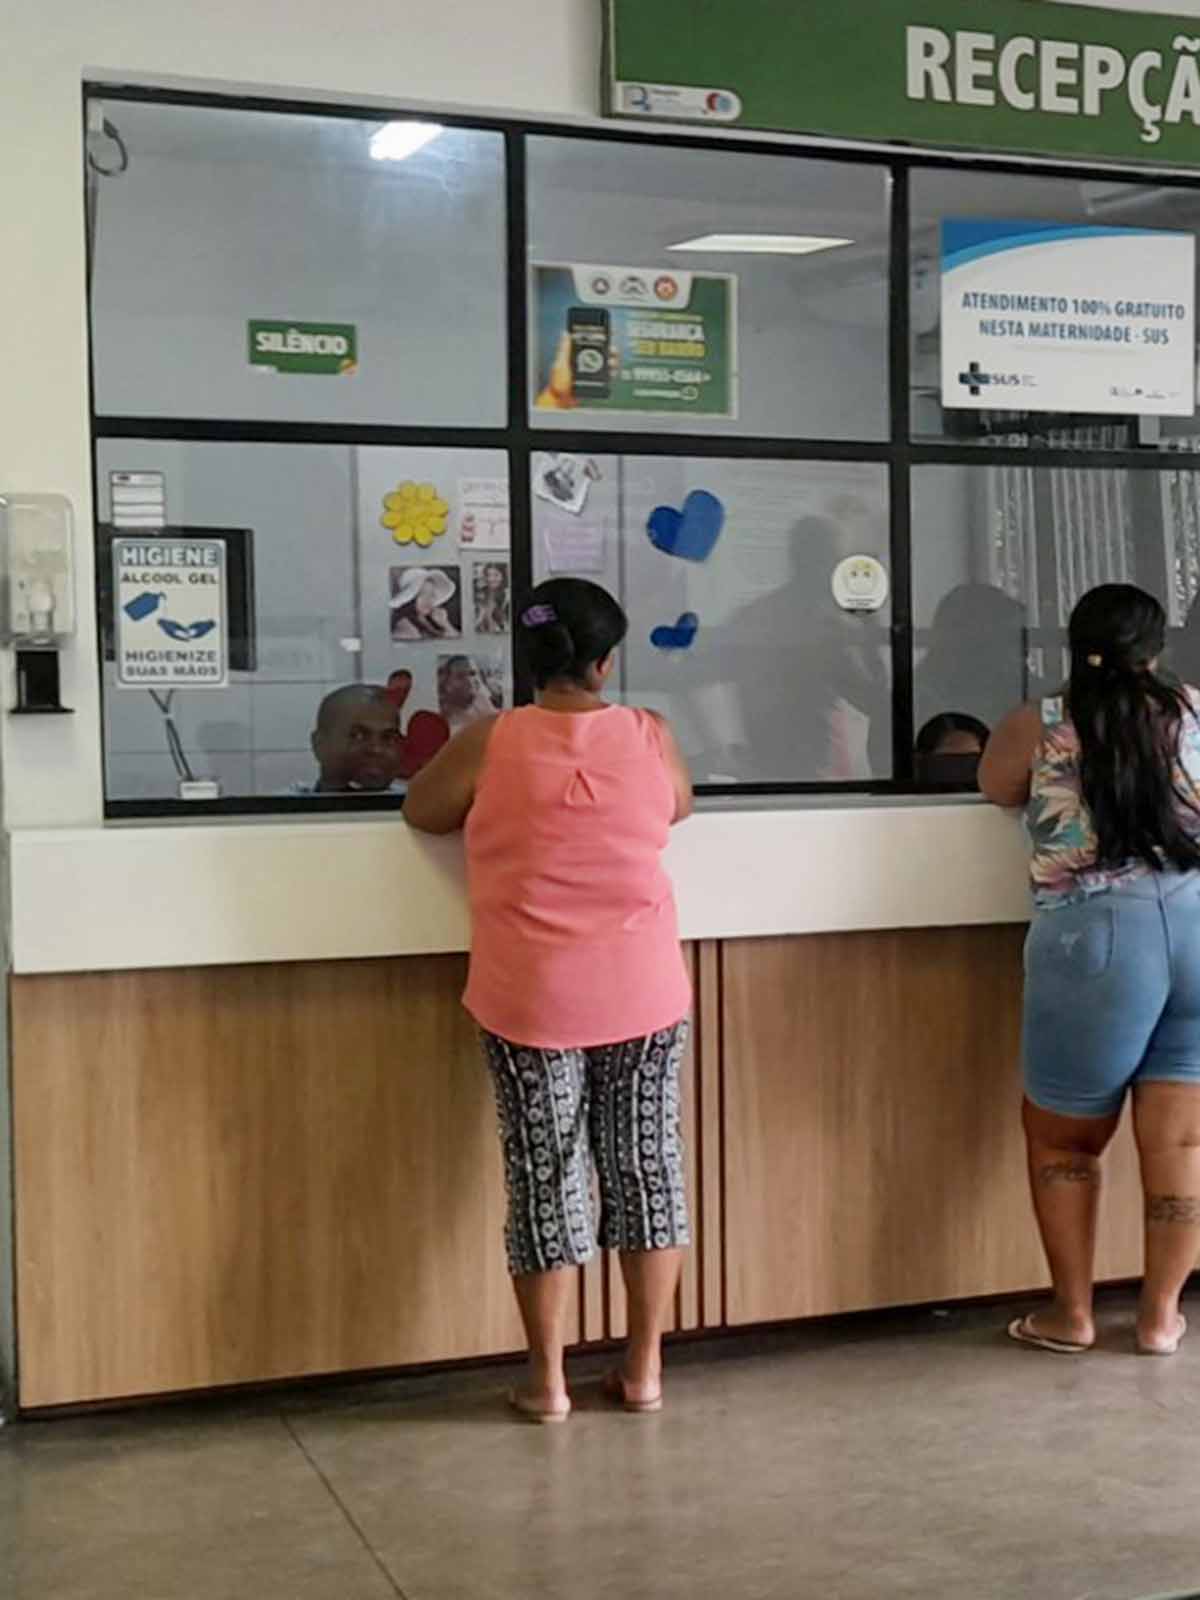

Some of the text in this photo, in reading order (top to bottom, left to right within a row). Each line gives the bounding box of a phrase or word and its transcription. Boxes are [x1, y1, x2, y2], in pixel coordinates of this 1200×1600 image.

[962, 292, 1186, 319] ATENDIMENTO 100% GRATUITO
[255, 327, 349, 355] SILÊNCIO
[978, 319, 1025, 338] NESTA
[1028, 321, 1131, 343] MATERNIDADE
[1143, 327, 1170, 345] SUS
[990, 374, 1021, 387] SUS
[121, 546, 219, 568] HIGIENE
[121, 572, 218, 585] ALCOOL GEL
[125, 650, 218, 663] HIGIENIZE
[125, 663, 218, 677] SUAS MÃOS
